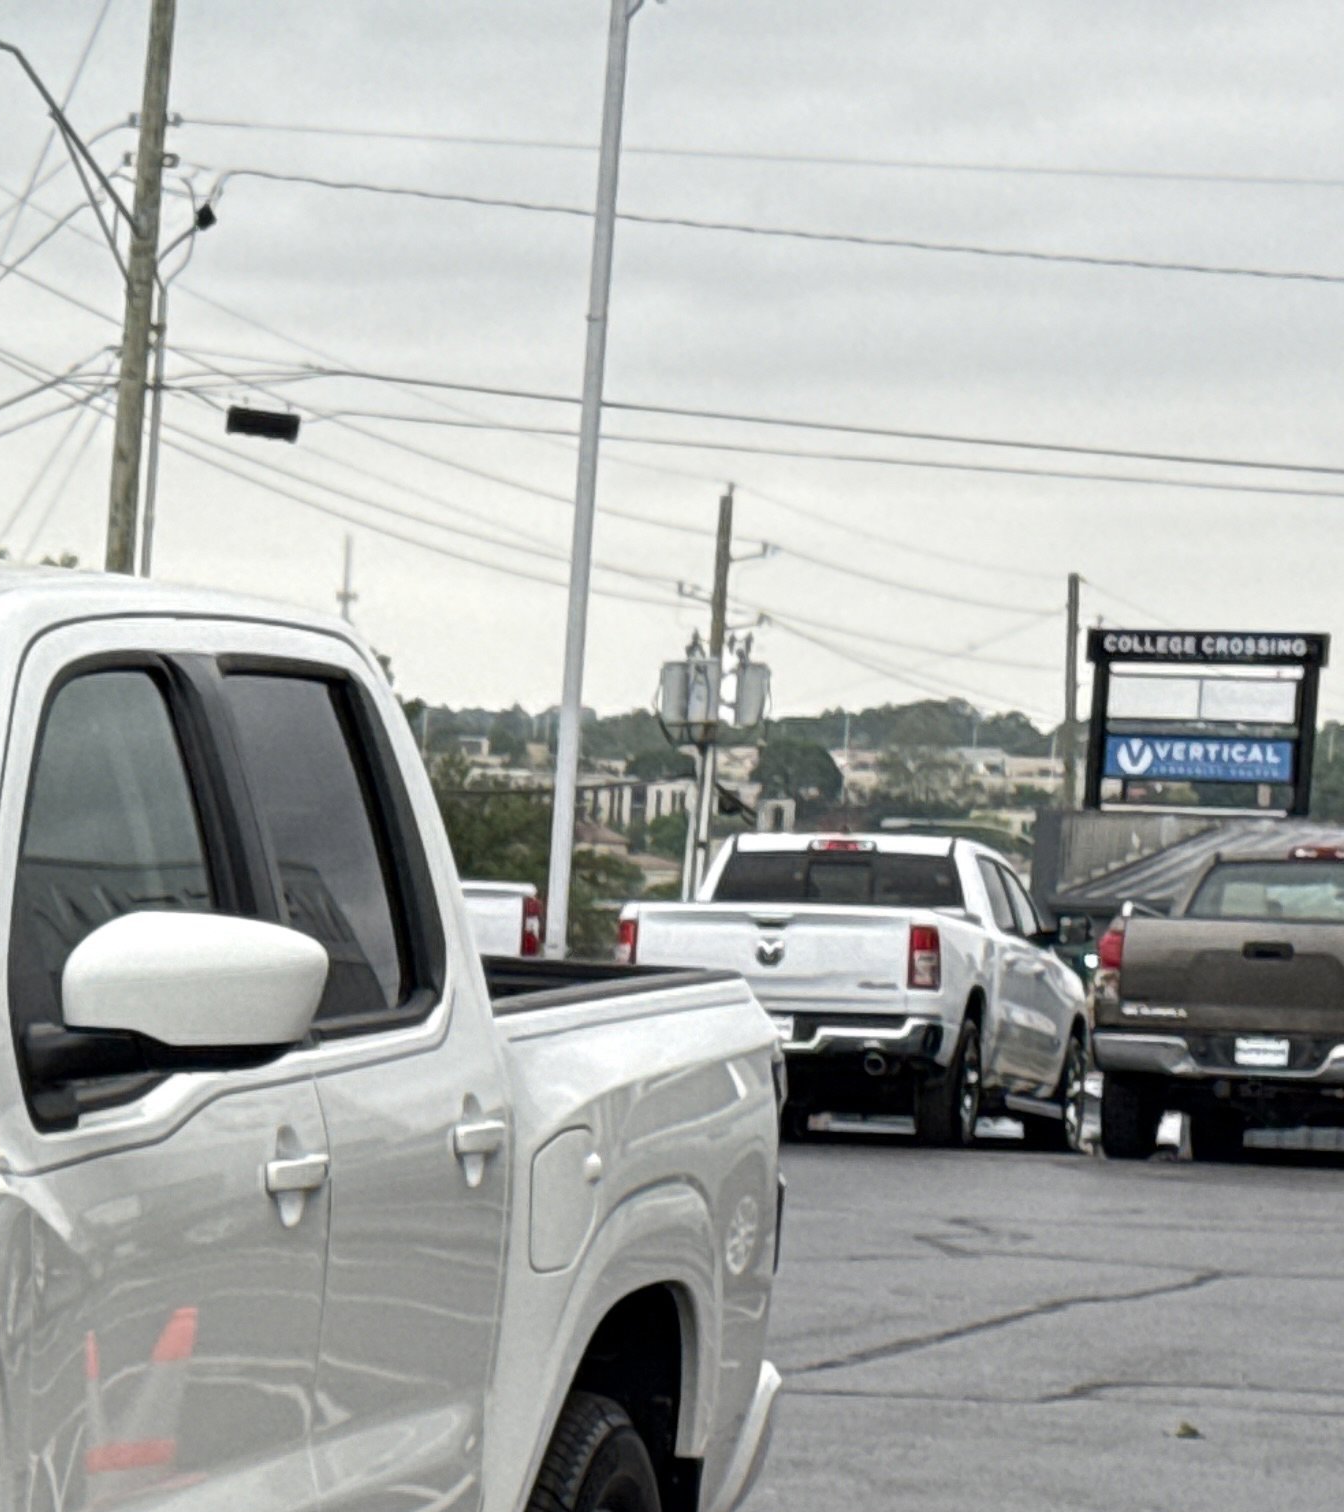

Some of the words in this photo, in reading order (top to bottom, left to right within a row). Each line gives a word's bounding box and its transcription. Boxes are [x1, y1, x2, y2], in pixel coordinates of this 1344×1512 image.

[1103, 634, 1195, 654] COLLEGE
[1201, 635, 1308, 657] CROSSING
[1155, 743, 1281, 764] VERTICAL
